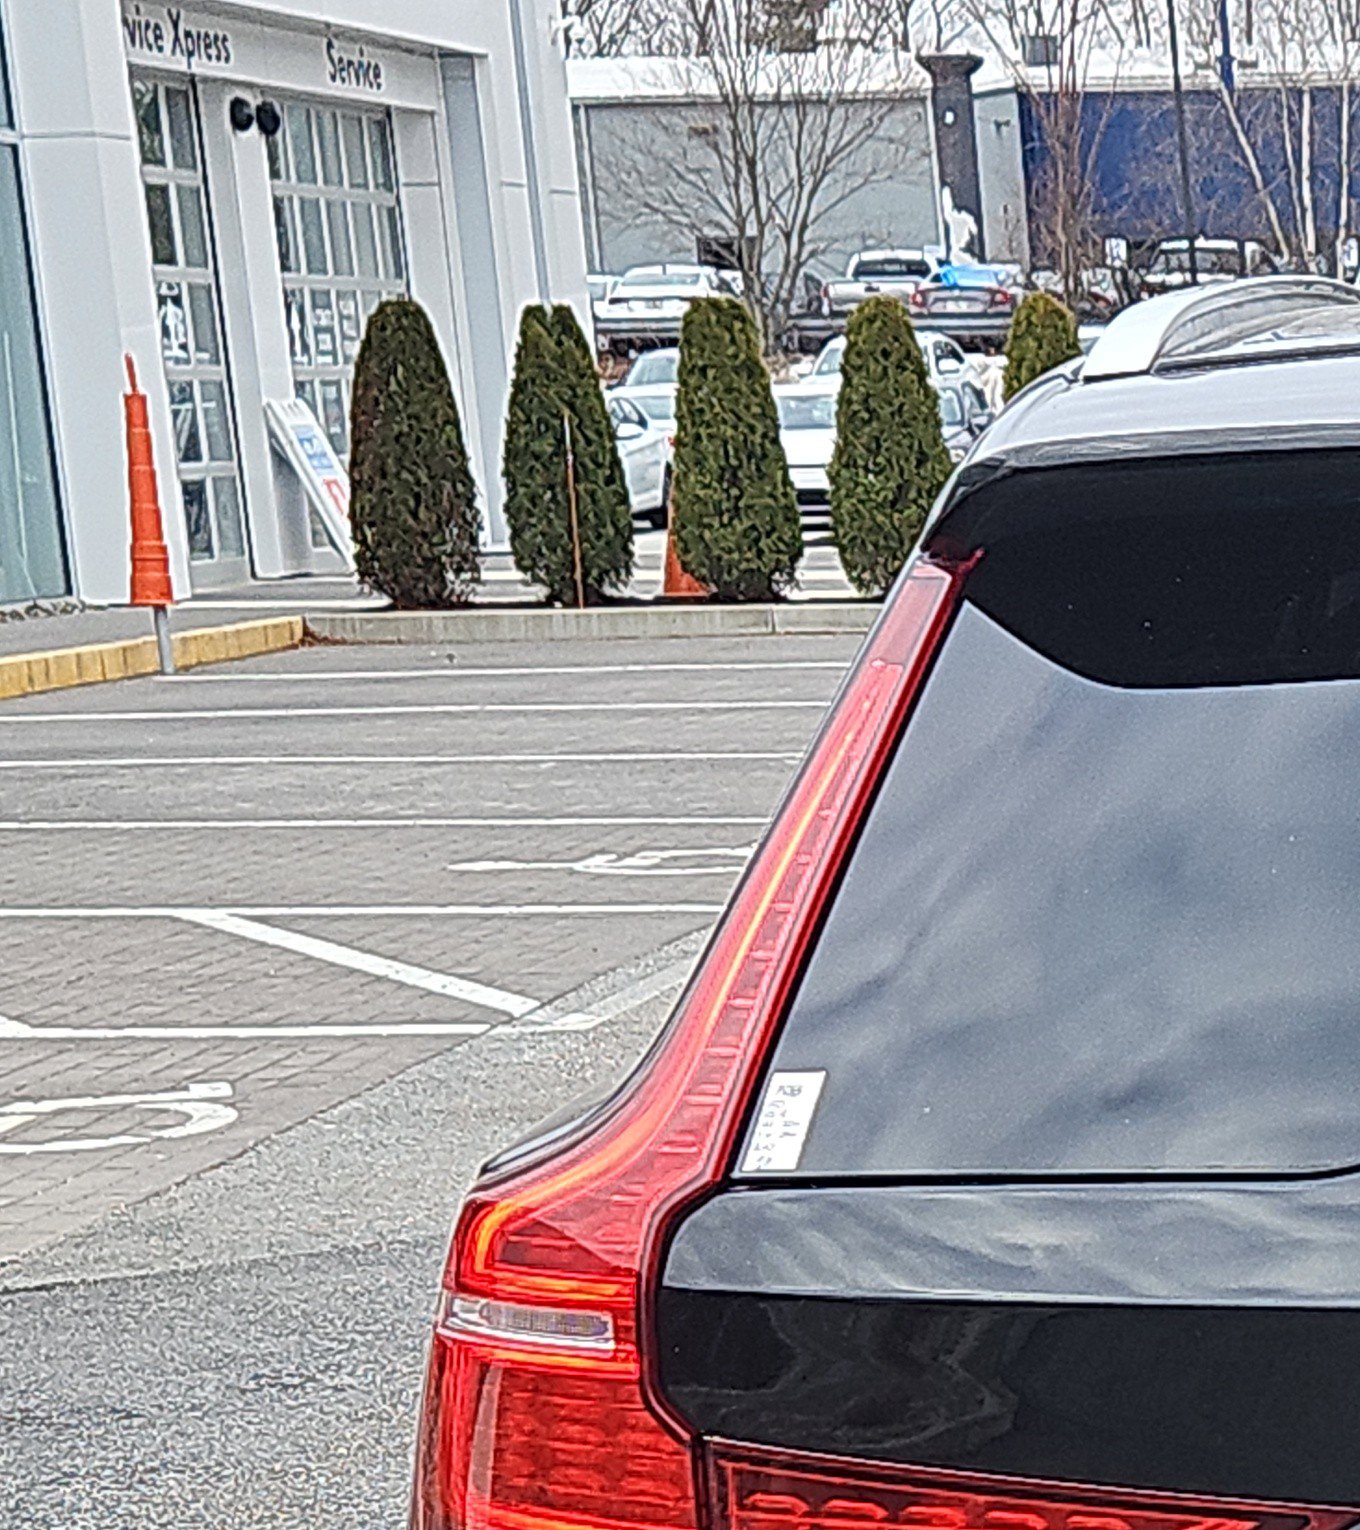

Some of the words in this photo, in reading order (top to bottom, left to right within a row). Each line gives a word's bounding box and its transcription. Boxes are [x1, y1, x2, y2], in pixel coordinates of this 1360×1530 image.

[122, 4, 164, 53] vice
[167, 8, 231, 70] Xpress
[324, 37, 382, 90] Service
